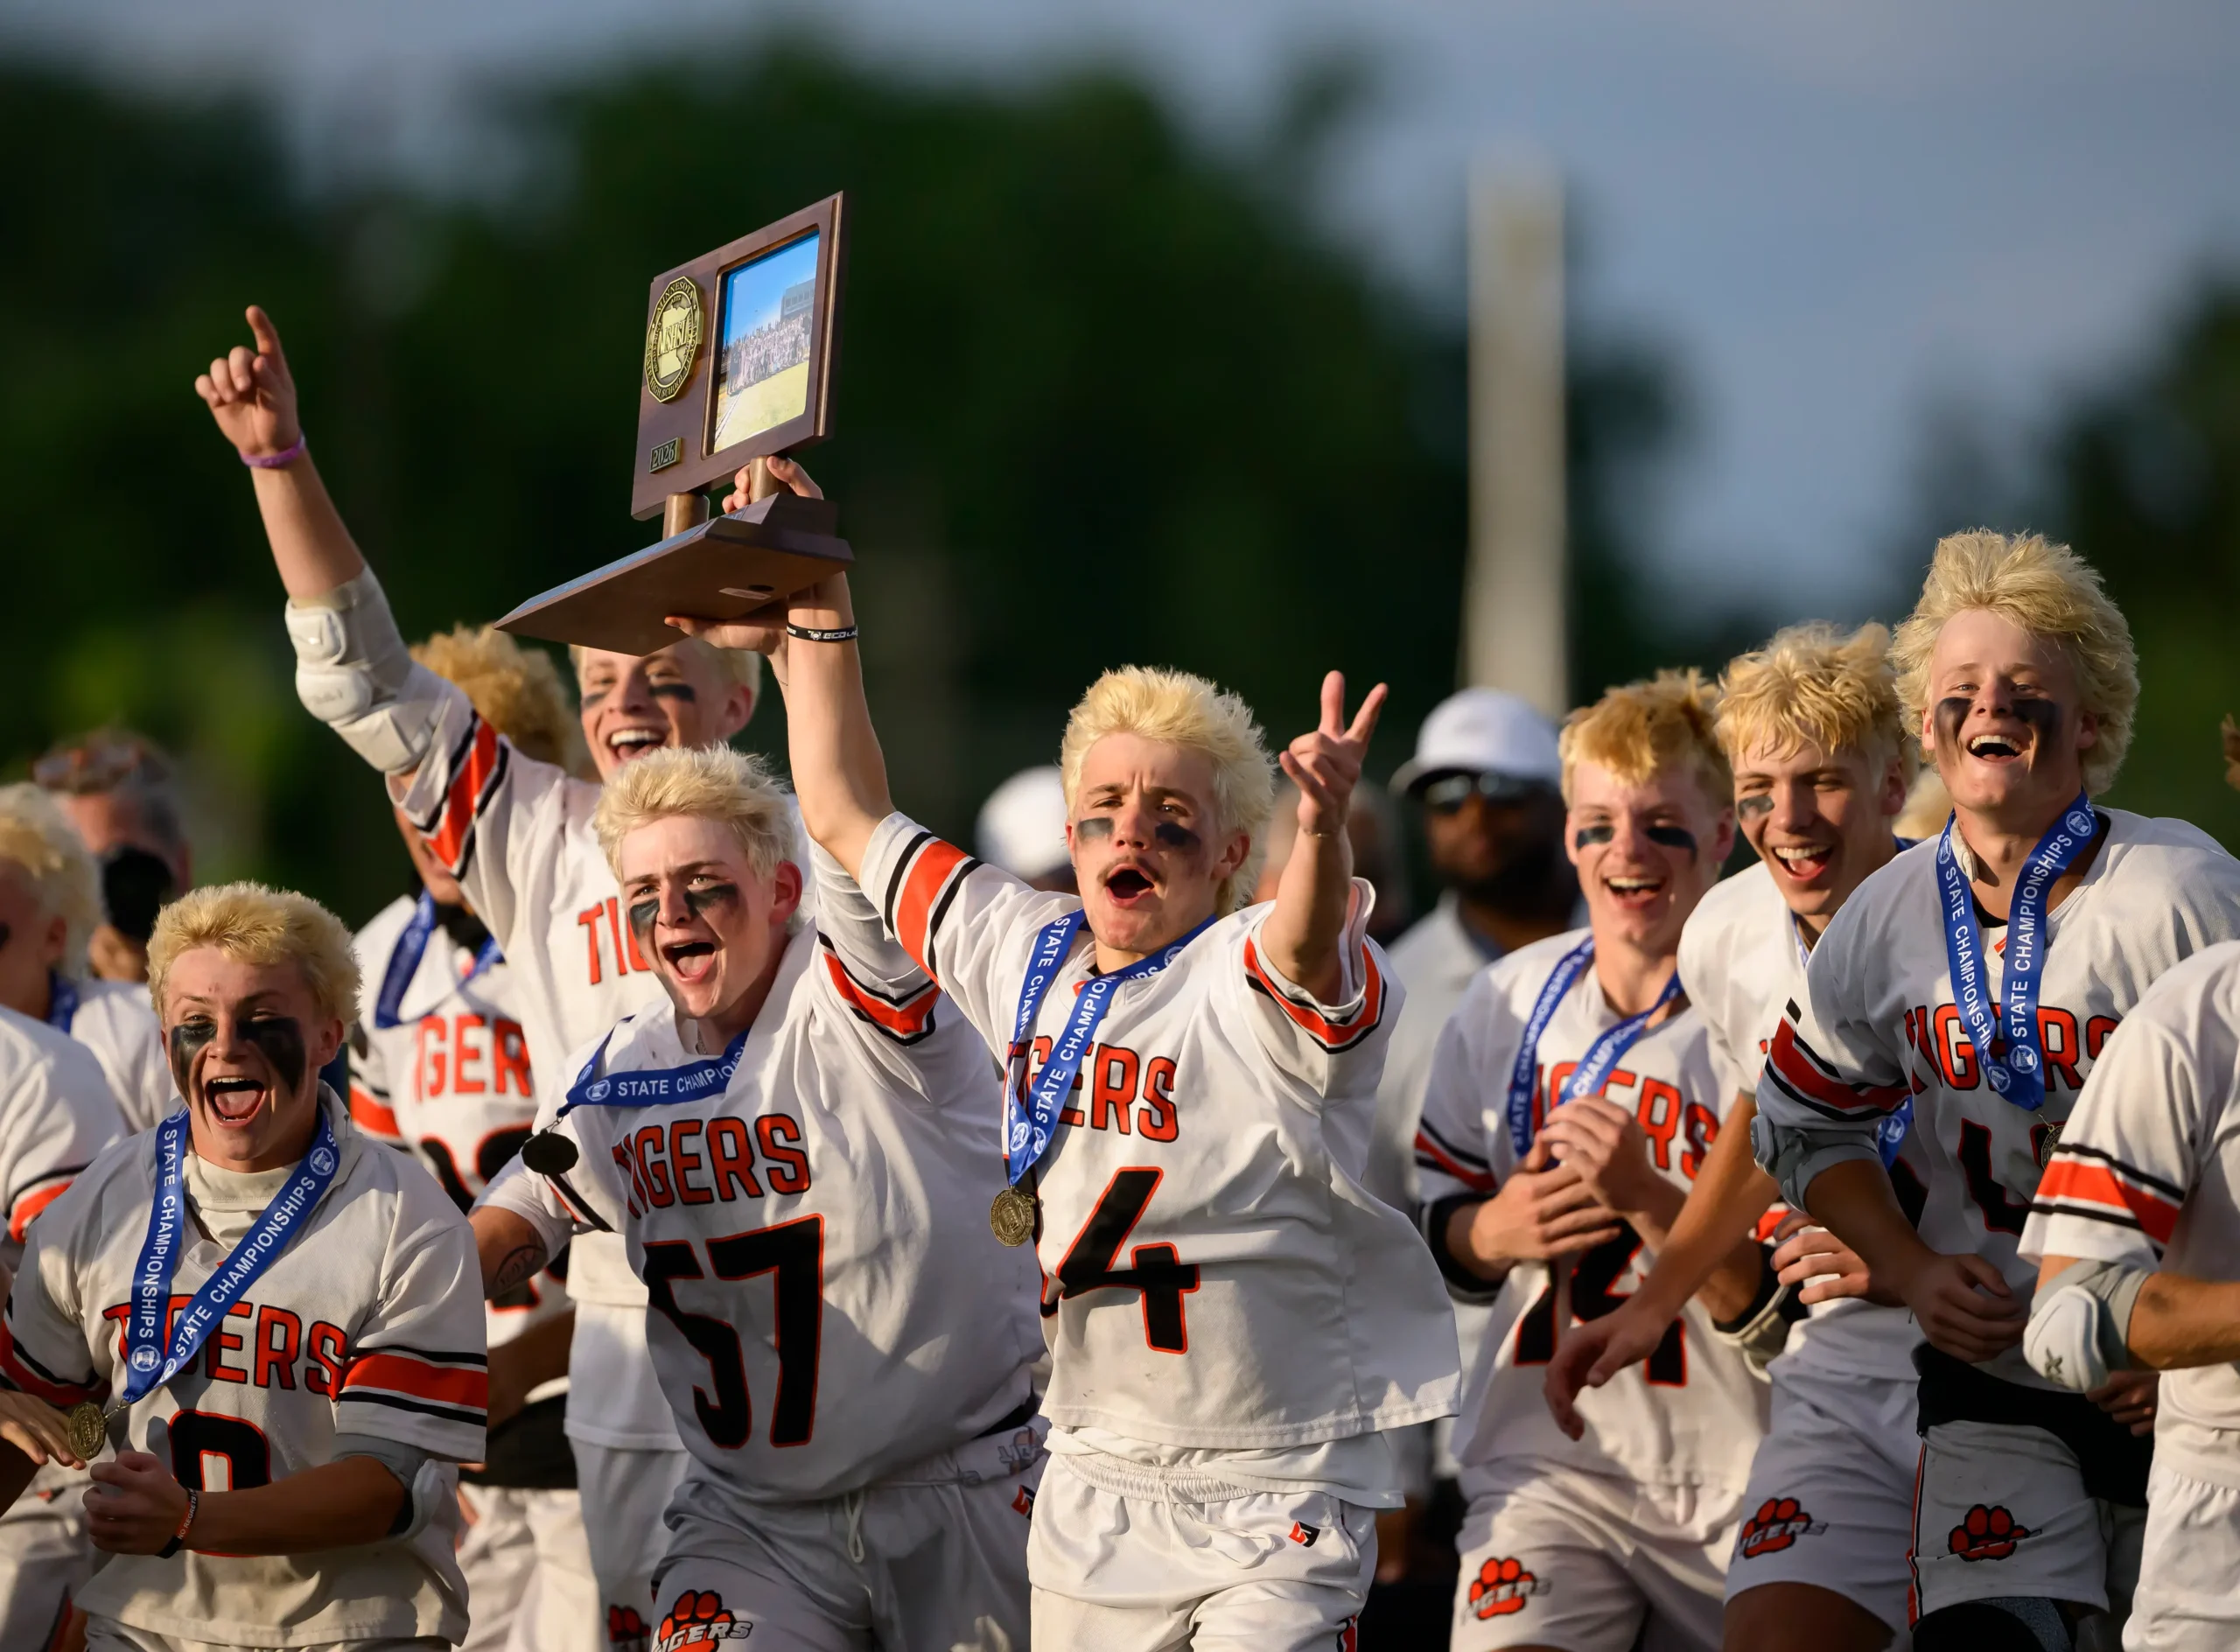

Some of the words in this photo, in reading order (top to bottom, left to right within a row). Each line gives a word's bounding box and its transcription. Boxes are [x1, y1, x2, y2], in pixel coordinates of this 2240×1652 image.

[657, 281, 693, 312] MINNESOTA
[657, 319, 687, 357] MSHSL
[652, 442, 675, 468] 2026
[1945, 866, 1964, 921] STATE
[2013, 833, 2073, 972] CHAMPIONSHIPS
[1038, 917, 1071, 968] STATE
[2012, 980, 2028, 1038] STATE
[618, 1080, 669, 1096] STATE
[1035, 1068, 1067, 1124] STATE
[164, 1130, 178, 1186] STATE
[139, 1194, 176, 1339] CHAMPIONSHIPS
[175, 1305, 213, 1357] STATE
[210, 1176, 316, 1304] CHAMPIONSHIPS
[1040, 1166, 1200, 1354] 4
[643, 1213, 825, 1450] 57
[178, 1529, 186, 1540] NO
